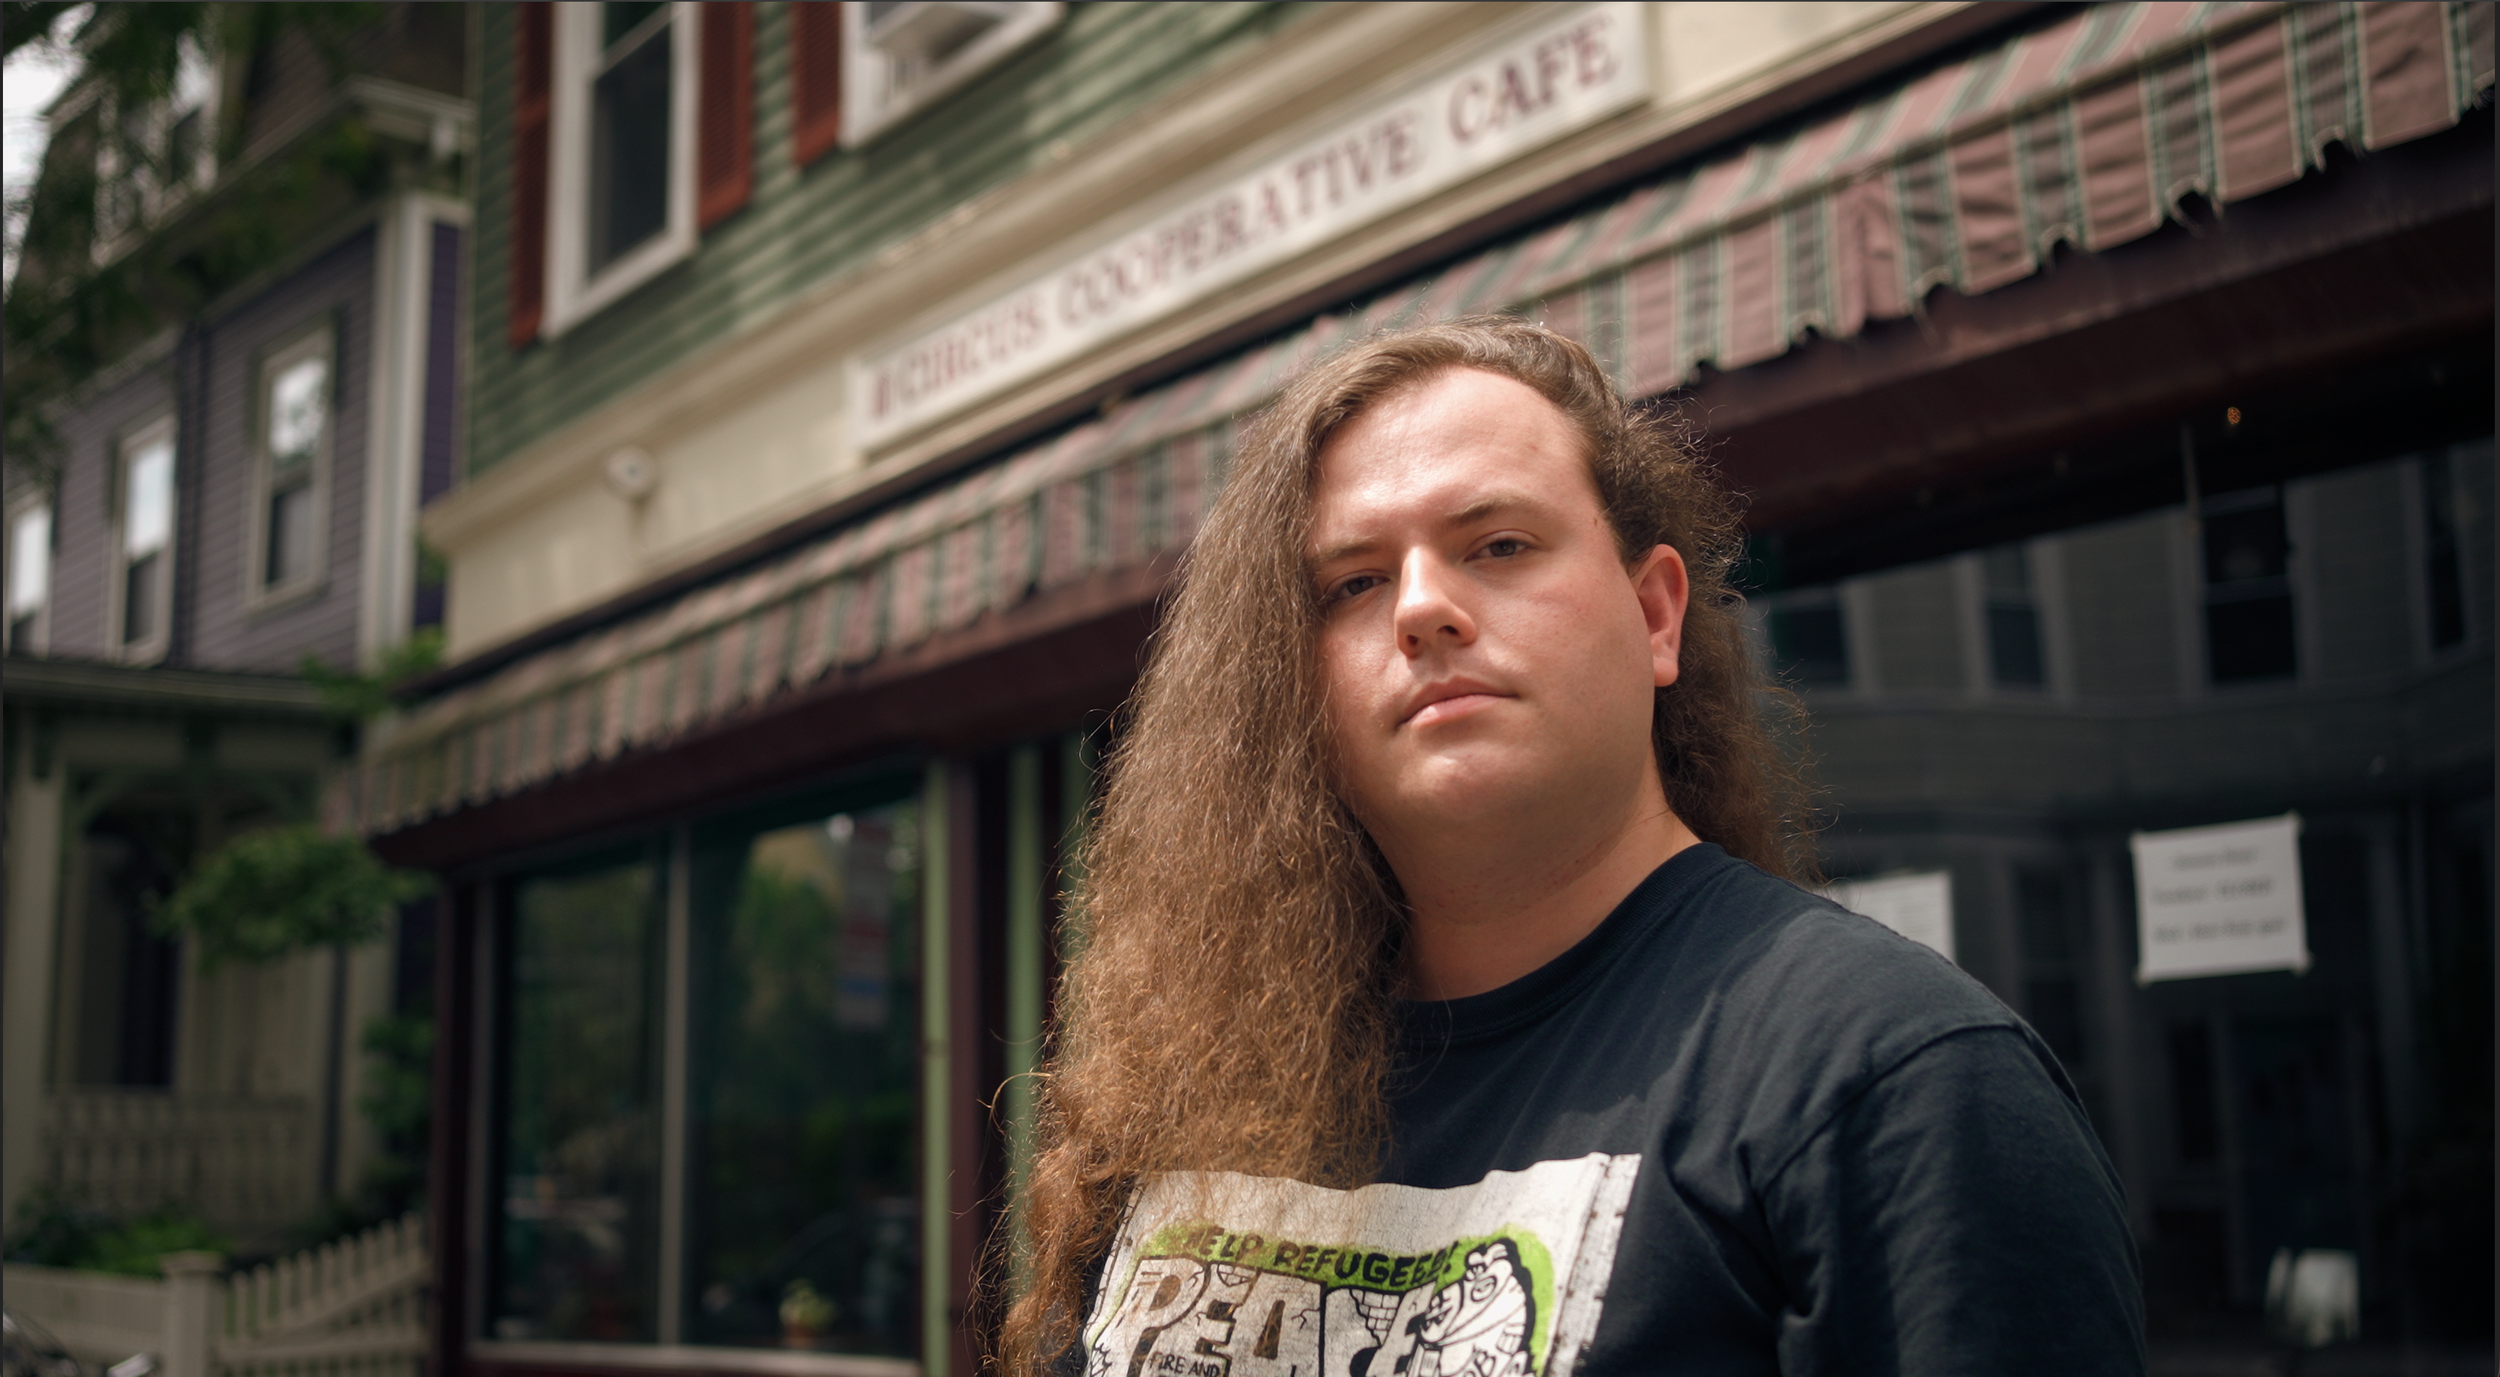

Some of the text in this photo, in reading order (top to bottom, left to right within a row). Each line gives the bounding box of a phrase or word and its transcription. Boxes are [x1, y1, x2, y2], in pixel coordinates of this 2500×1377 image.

[902, 17, 1618, 402] CIRCUS COOPERATIVE CAFE
[1189, 1361, 1220, 1377] AND
